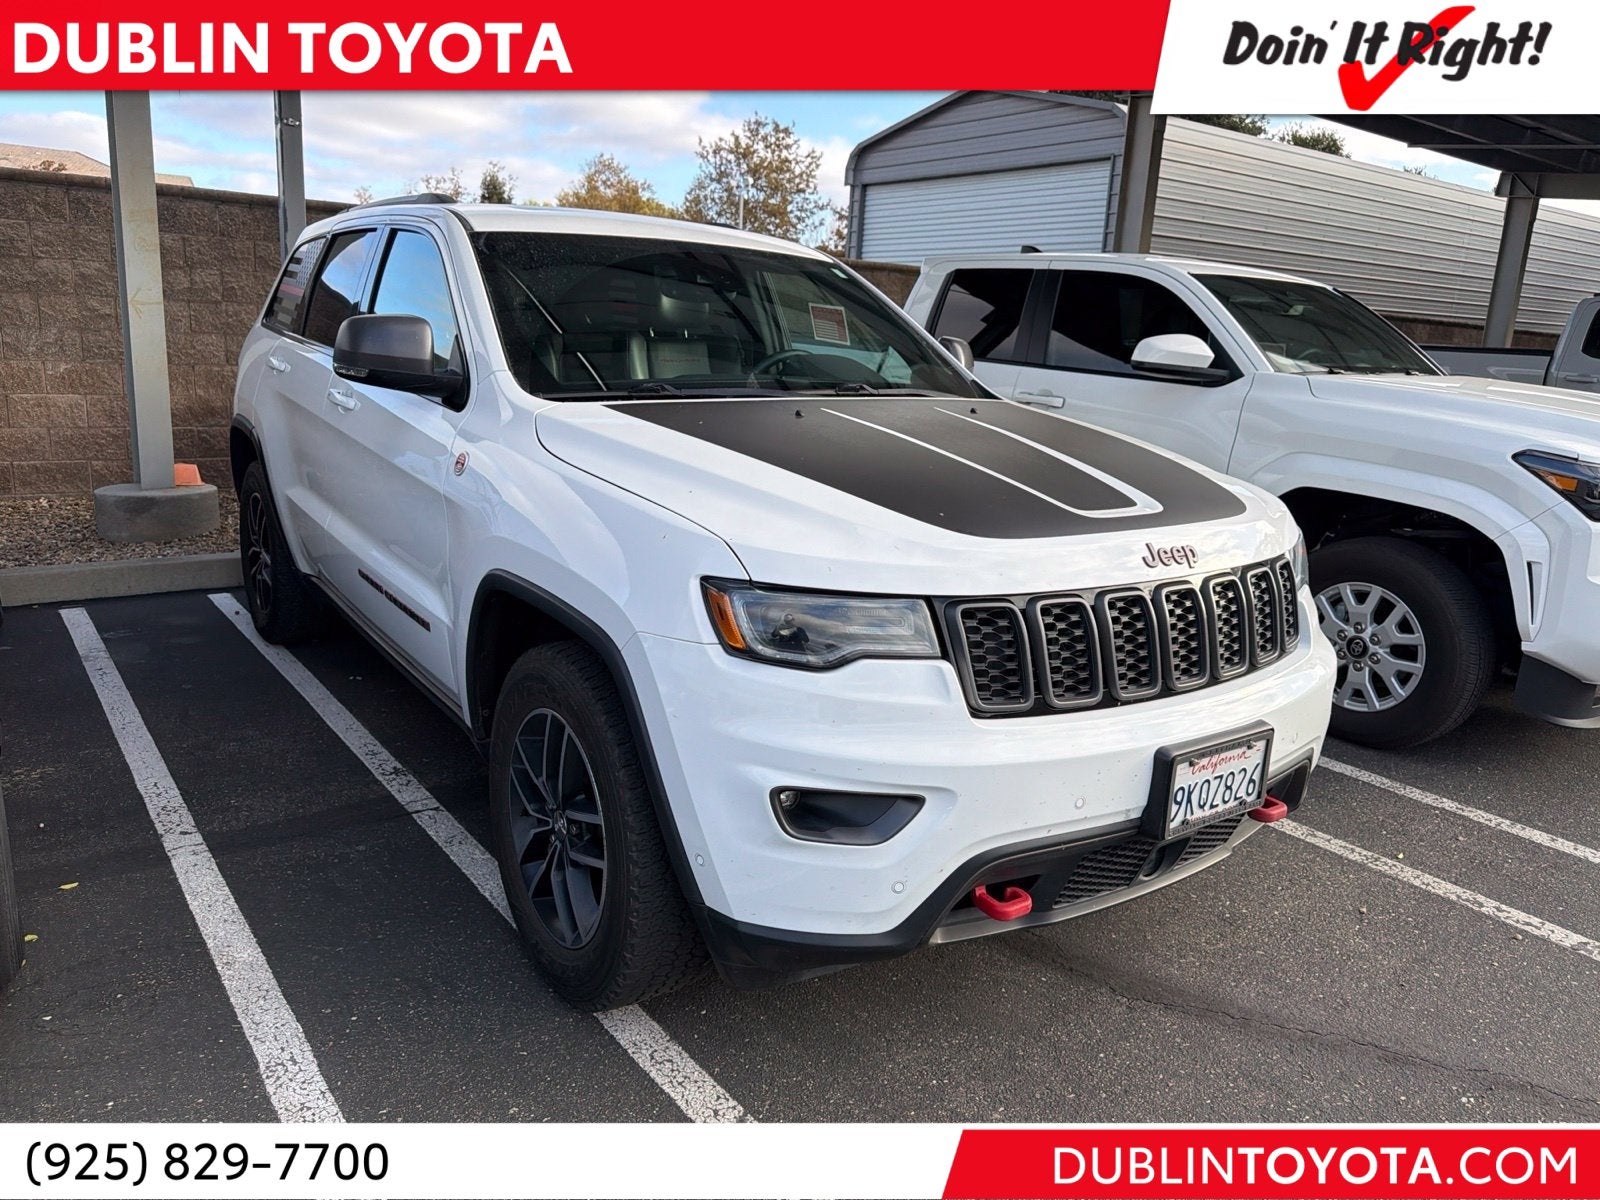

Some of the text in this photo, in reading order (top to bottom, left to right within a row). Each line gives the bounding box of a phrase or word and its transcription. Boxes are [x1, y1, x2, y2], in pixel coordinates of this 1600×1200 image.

[1141, 542, 1199, 569] Jeep
[1191, 750, 1252, 775] California
[1170, 762, 1261, 822] 9KQZ826
